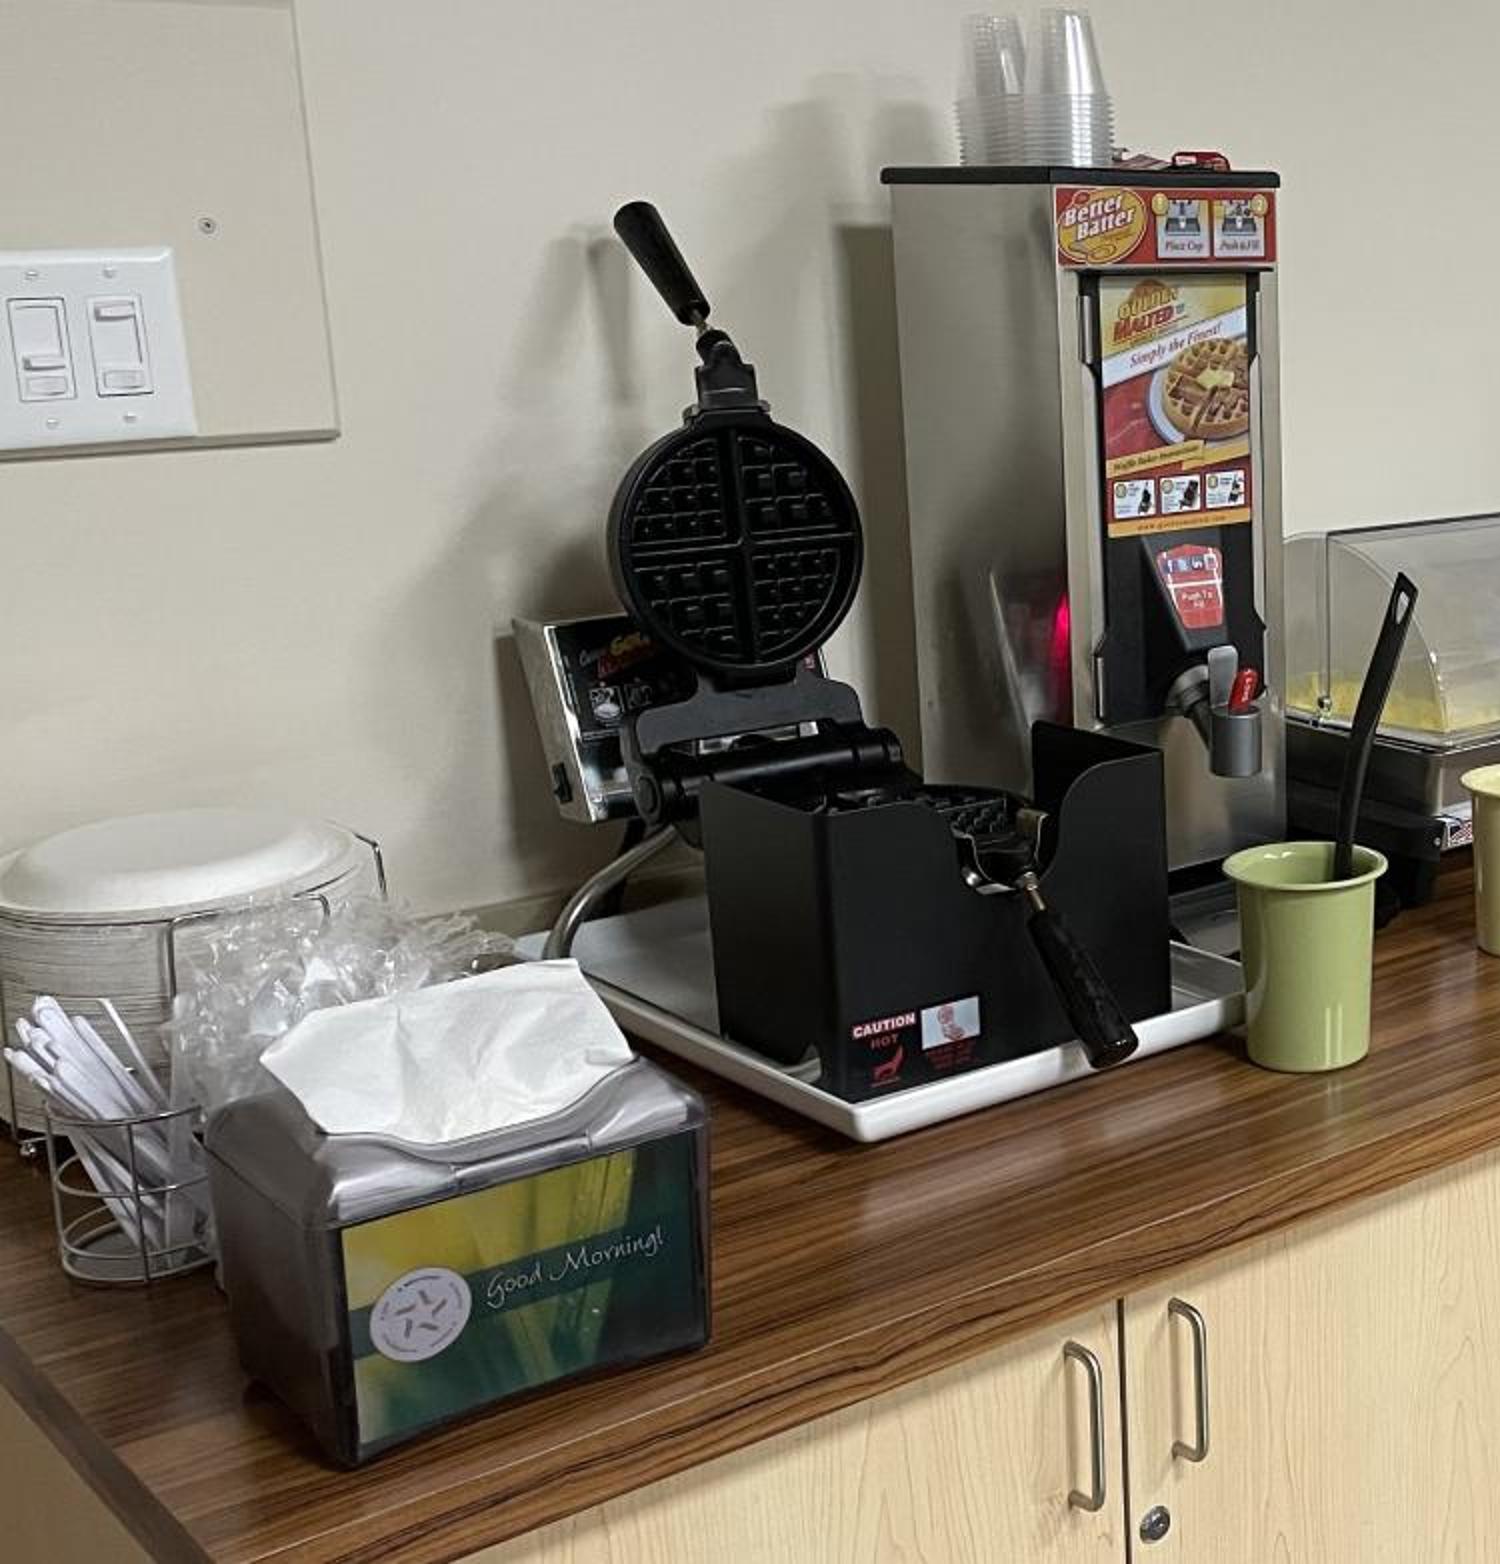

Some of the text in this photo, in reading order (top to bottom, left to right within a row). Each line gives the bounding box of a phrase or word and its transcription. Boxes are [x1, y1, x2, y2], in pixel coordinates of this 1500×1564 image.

[1062, 195, 1123, 228] Better
[1076, 207, 1136, 242] Batter
[1130, 344, 1167, 369] Simply
[1169, 338, 1185, 352] the
[852, 1012, 916, 1039] CAUTION
[870, 1033, 899, 1049] HOT
[486, 1262, 543, 1309] Good
[549, 1225, 665, 1282] Morning!
